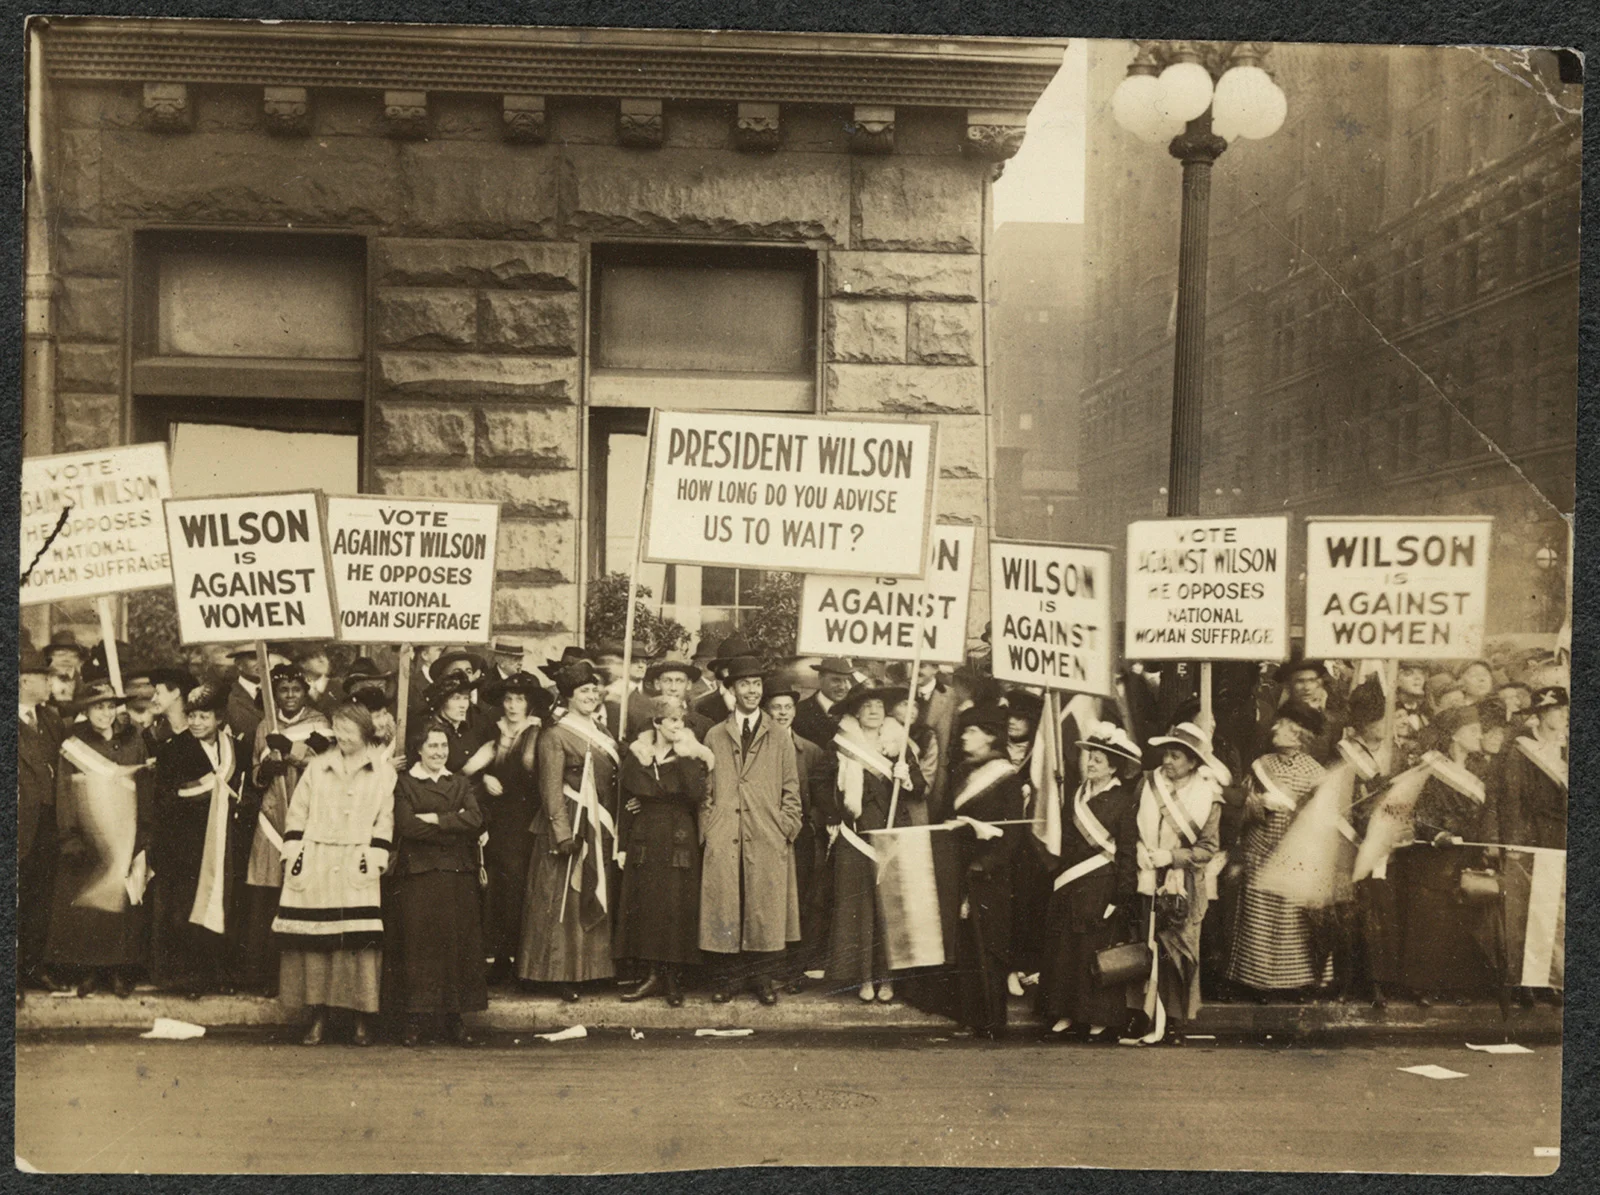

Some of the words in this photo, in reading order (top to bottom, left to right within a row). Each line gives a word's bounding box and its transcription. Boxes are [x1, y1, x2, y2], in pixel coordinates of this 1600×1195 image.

[667, 428, 808, 472] PRESIDENT
[818, 434, 913, 479] WILSON
[46, 459, 113, 481] VOTE
[21, 484, 85, 517] GAINST
[677, 478, 713, 502] HOW
[717, 481, 757, 506] LONG
[765, 483, 787, 507] DO
[794, 484, 828, 510] YOU
[833, 488, 897, 514] ADVISE
[27, 523, 52, 541] HE
[60, 509, 152, 538] OPPOSES
[179, 509, 310, 548] WILSON
[379, 509, 449, 527] VOTE
[704, 514, 732, 543] US
[742, 516, 770, 546] TO
[333, 529, 415, 557] AGAINST
[420, 531, 487, 560] WILSON
[1176, 527, 1237, 543] VOTE
[53, 538, 138, 561] NATIONAL
[234, 551, 257, 565] IS
[1214, 547, 1277, 574] WILSON
[1325, 534, 1476, 568] WILSON
[84, 552, 171, 580] SUFFRAGE
[347, 563, 373, 582] HE
[380, 564, 472, 586] OPPOSES
[1002, 556, 1097, 600] WILSON
[1384, 572, 1408, 585] IS
[189, 568, 315, 599] AGAINST
[1177, 582, 1265, 600] OPPOSES
[368, 590, 451, 608] NATIONAL
[818, 588, 957, 620] AGAINST
[1039, 600, 1057, 613] IS
[1323, 591, 1472, 616] AGAINST
[200, 601, 306, 629] WOMEN
[393, 611, 481, 630] SUFFRAGE
[1167, 607, 1244, 624] NATIONAL
[825, 618, 937, 649] WOMEN
[1002, 613, 1098, 652] AGAINST
[1134, 628, 1187, 644] WOMAN
[1191, 628, 1274, 644] SUFFRAGE
[1332, 622, 1451, 645] WOMEN
[1008, 644, 1087, 682] WOMEN
